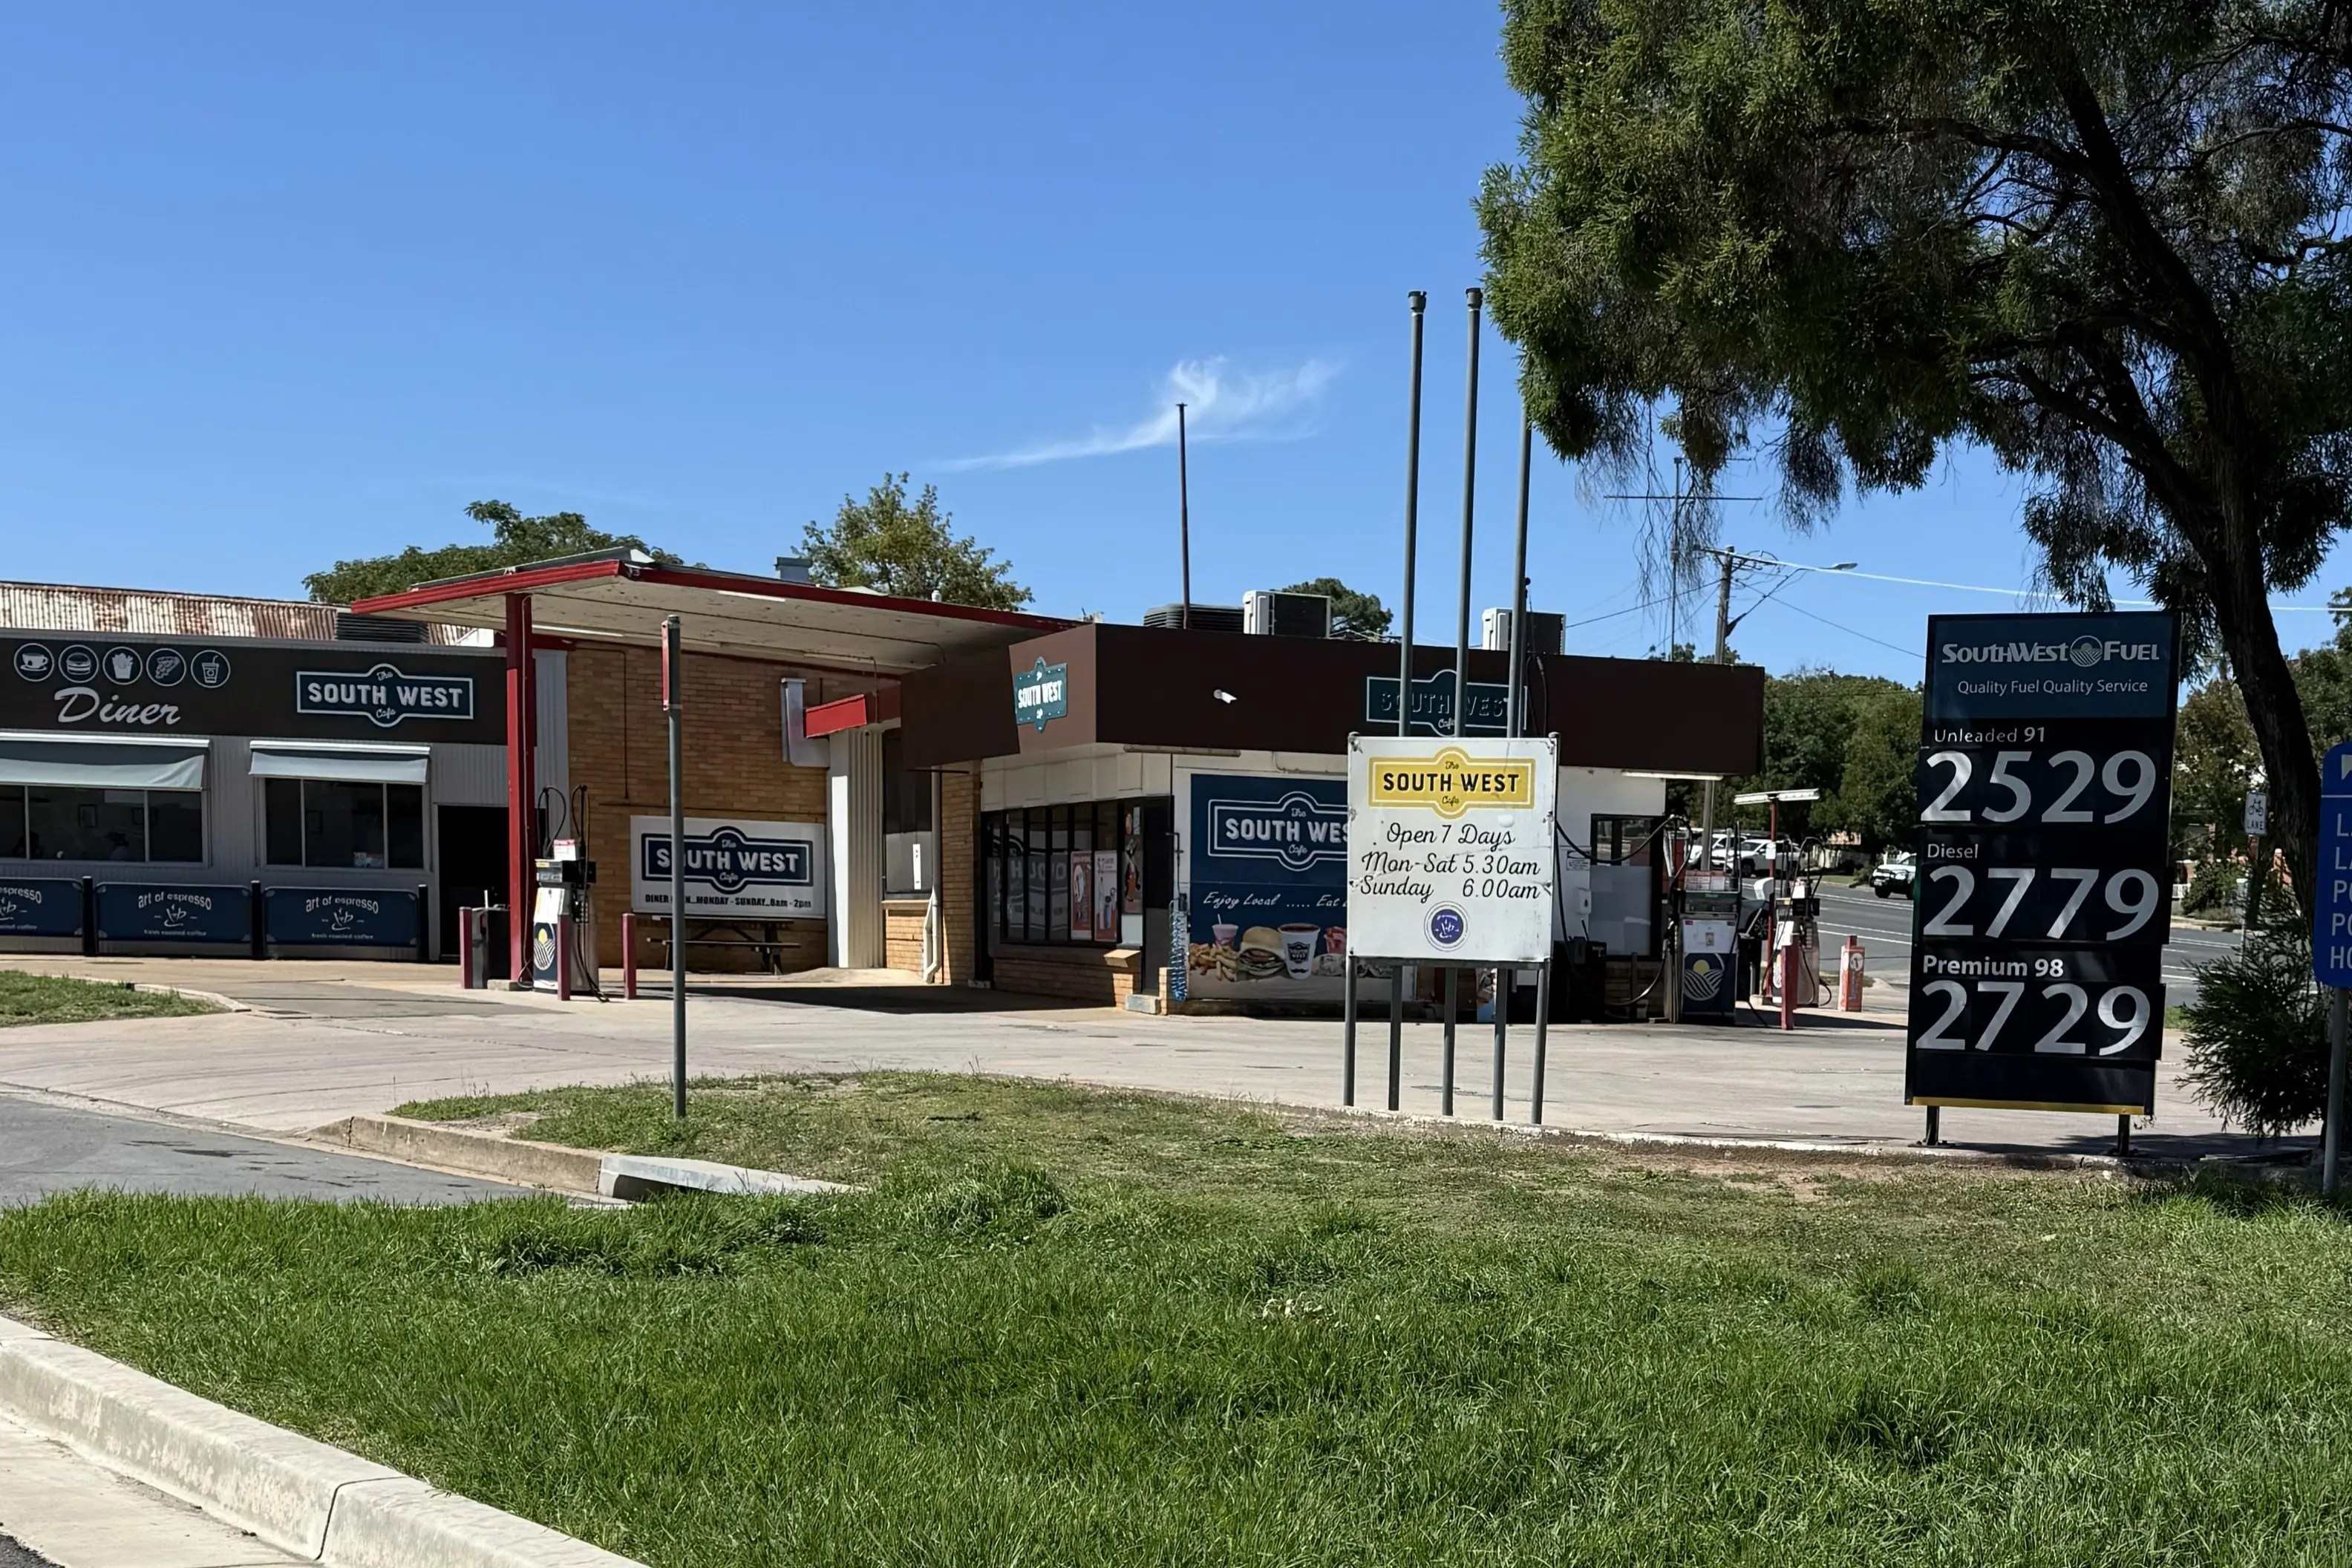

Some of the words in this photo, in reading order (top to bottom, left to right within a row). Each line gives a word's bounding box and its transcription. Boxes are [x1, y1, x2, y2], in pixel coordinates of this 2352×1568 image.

[307, 682, 387, 705] SOUTH
[396, 685, 463, 708] WEST
[1958, 680, 2008, 696] Quality
[2011, 679, 2039, 693] Fuel
[2043, 679, 2093, 696] Quality
[2097, 679, 2148, 693] Service
[54, 687, 180, 725] Diner
[1935, 728, 2017, 742] Unleaded
[2024, 726, 2045, 742] 91
[1383, 773, 1451, 792] SOUTH
[1461, 774, 1519, 792] WEST
[1921, 750, 2157, 824] 2529
[1226, 818, 1299, 841] SOUTH
[2247, 820, 2264, 830] LANE
[1387, 822, 1437, 851] Open
[1442, 824, 1452, 843] 7
[1458, 823, 1515, 852] Days
[656, 849, 731, 870] SUTH
[738, 852, 799, 872] WEST
[1927, 843, 1979, 859] Diesel
[1362, 851, 1457, 874] Mon-Sat
[1463, 854, 1541, 875] 5.30am
[138, 892, 151, 909] art
[154, 891, 164, 902] of
[167, 893, 212, 910] espresso
[645, 894, 669, 904] DINER
[1203, 891, 1240, 909] Enjoy
[1243, 893, 1281, 906] Local
[1316, 895, 1339, 906] Eat
[1360, 875, 1434, 904] Sunday
[1463, 878, 1541, 899] 6.00am
[306, 897, 319, 912] art
[322, 895, 332, 906] of
[335, 898, 379, 914] espresso
[1923, 865, 2159, 941] 2779
[1923, 955, 2028, 976] Premium
[2034, 958, 2064, 978] 98
[1915, 979, 2151, 1056] 2729
